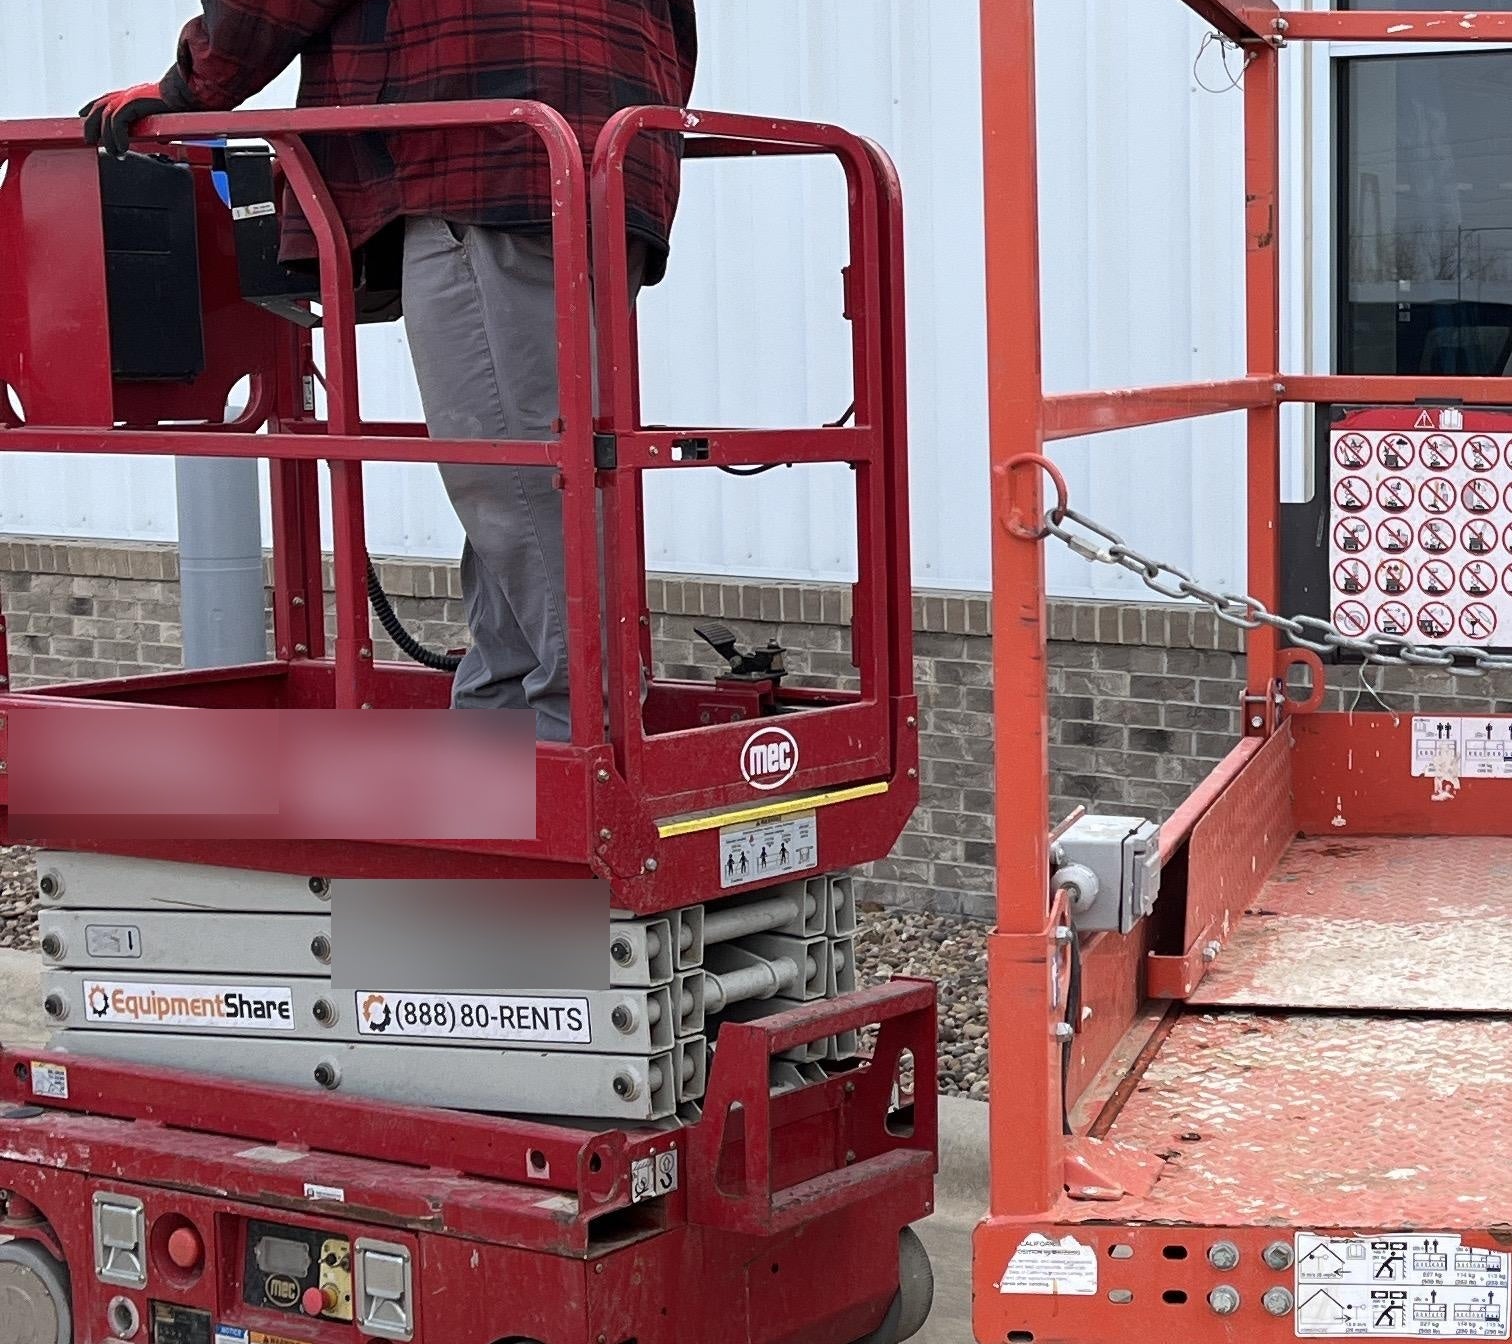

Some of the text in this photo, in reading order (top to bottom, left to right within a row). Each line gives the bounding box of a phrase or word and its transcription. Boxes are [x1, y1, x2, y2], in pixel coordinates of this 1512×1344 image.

[111, 988, 291, 1021] EquipmentShare
[395, 999, 583, 1033] (888) 80-RENTS
